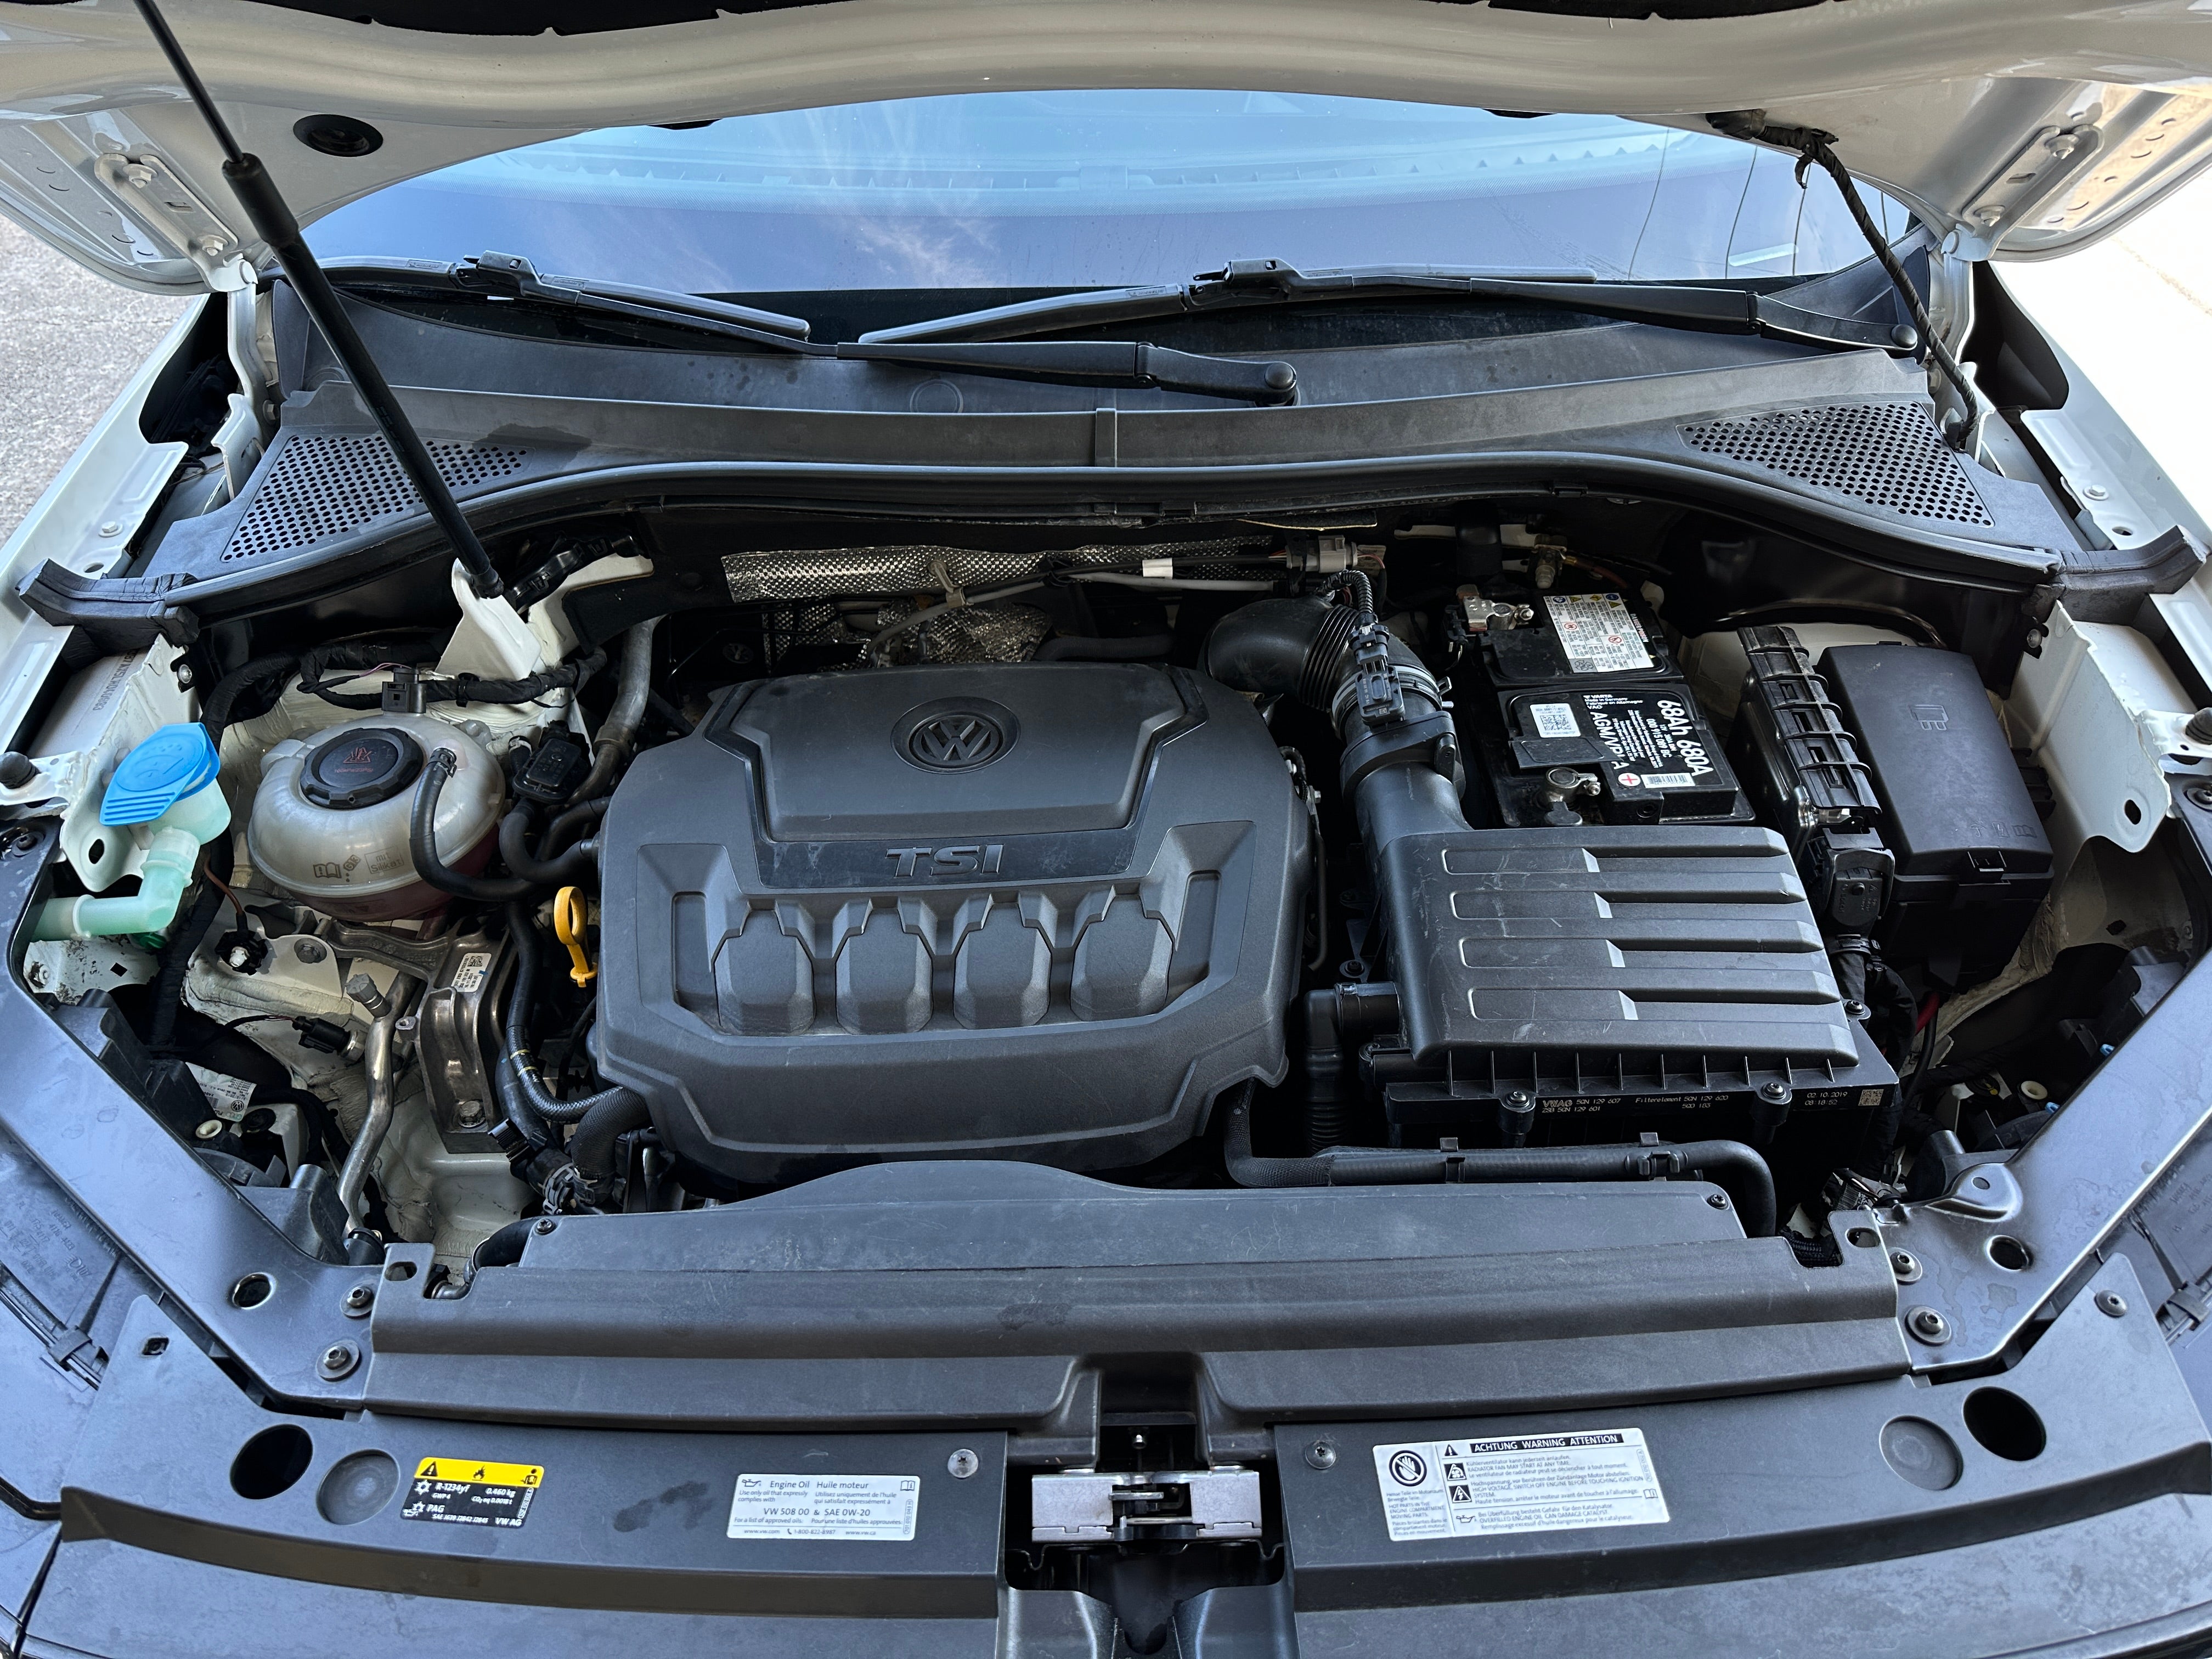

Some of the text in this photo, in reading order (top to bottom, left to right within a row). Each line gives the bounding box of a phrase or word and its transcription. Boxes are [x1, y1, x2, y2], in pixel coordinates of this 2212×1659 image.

[1646, 719, 1657, 729] 000
[1651, 728, 1663, 738] 915
[1657, 700, 1713, 776] 68Ah 680A
[909, 714, 1003, 769] VW
[346, 856, 359, 870] G13
[376, 852, 391, 862] mit
[885, 844, 1005, 878] TSI
[371, 860, 402, 872] Silikat
[1542, 1099, 1572, 1108] VWAG
[1474, 1435, 1618, 1451] ACHTUNG WARNING ATTENTION
[435, 1482, 470, 1494] R-1234yf
[770, 1480, 797, 1489] Engine
[426, 1504, 445, 1513] PAG
